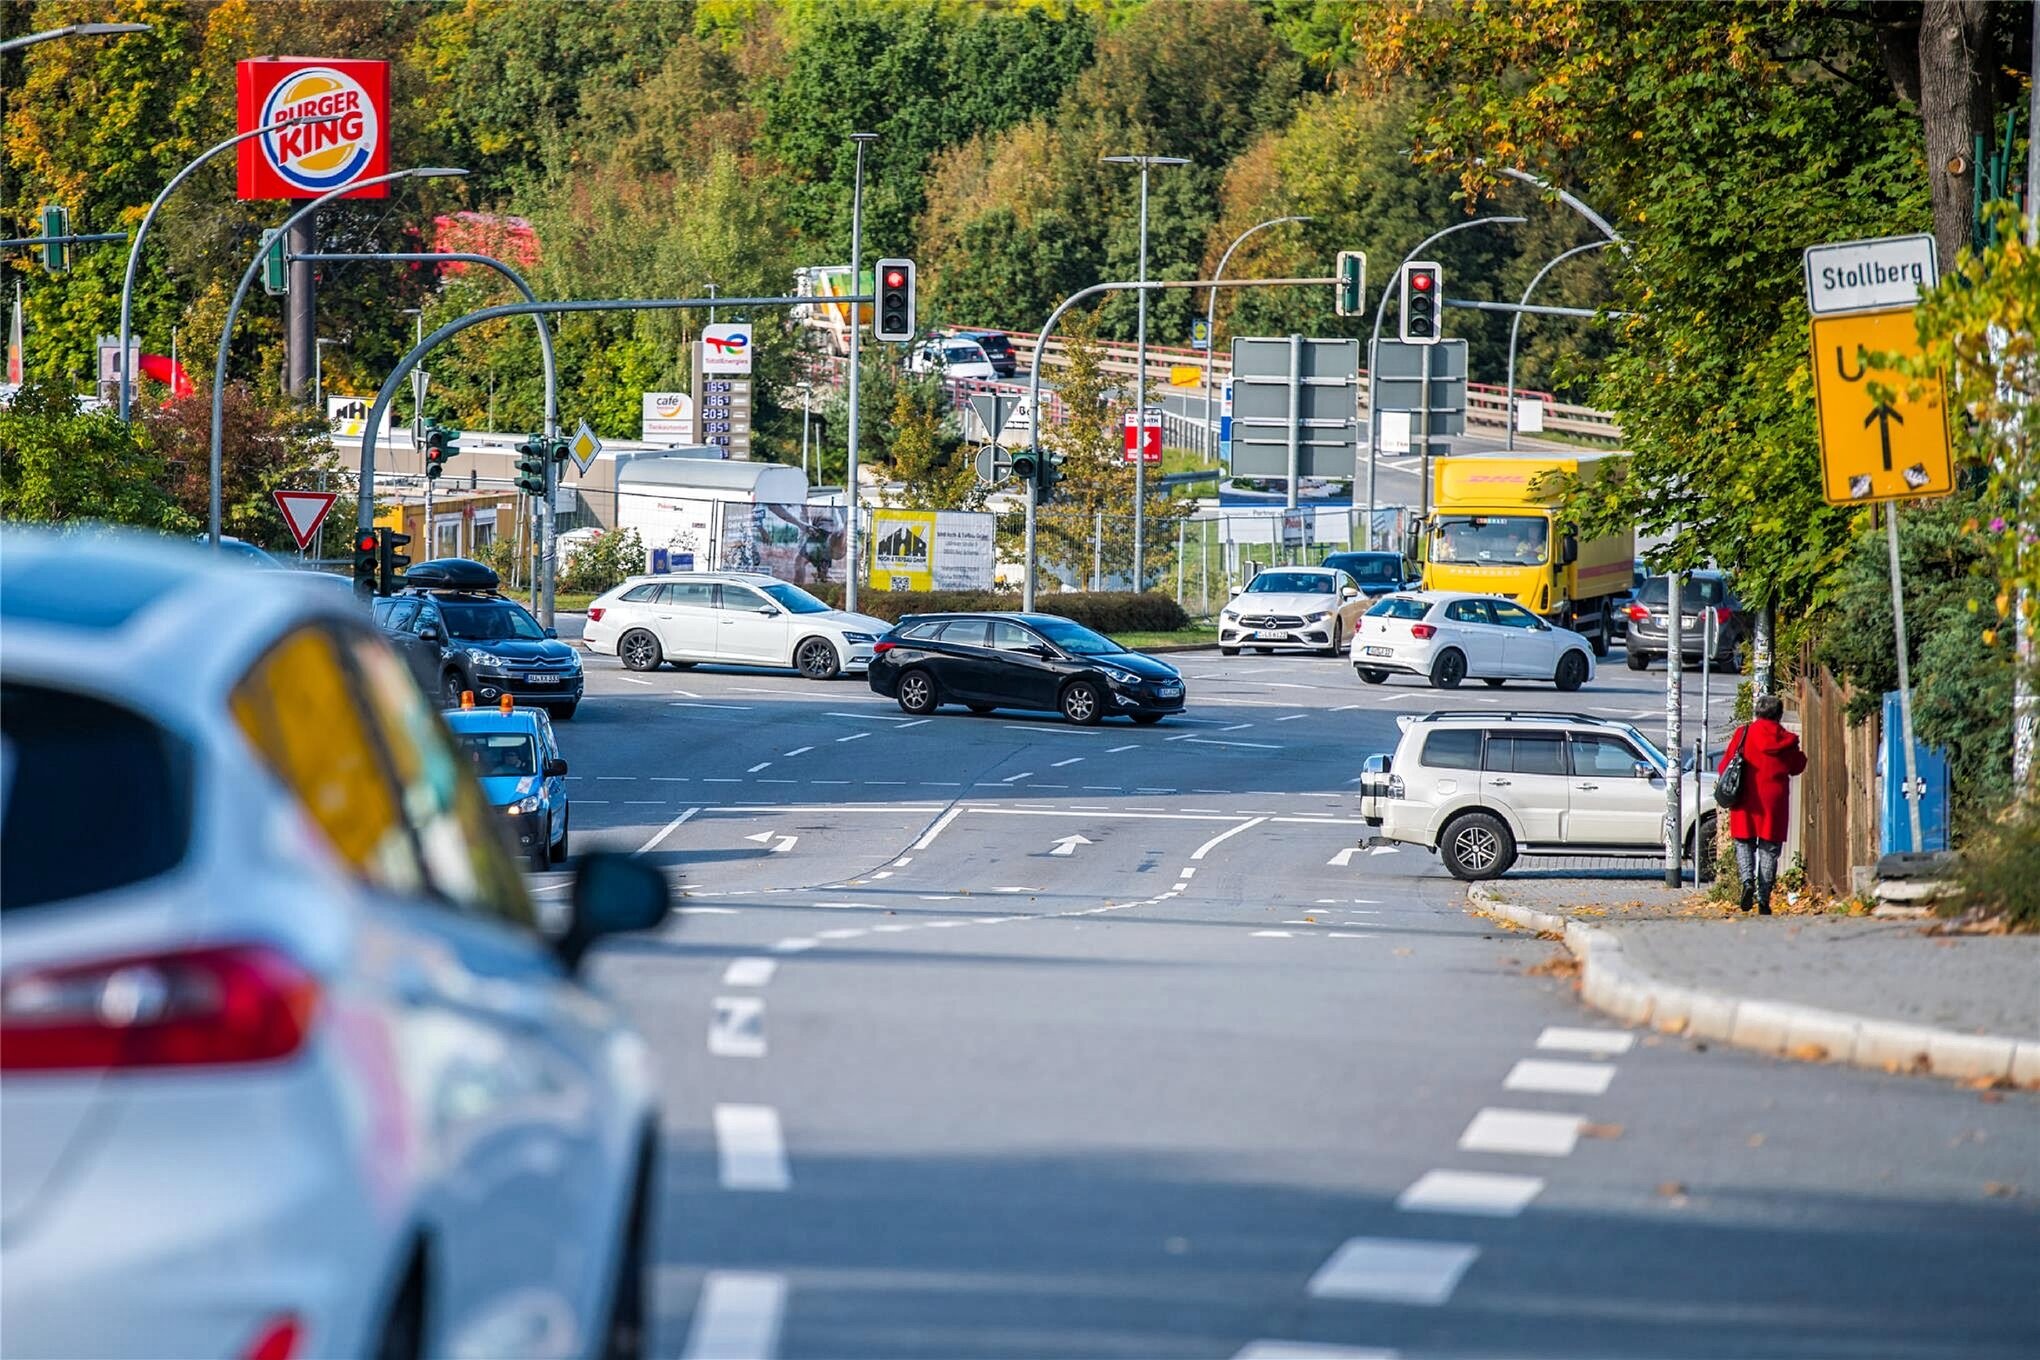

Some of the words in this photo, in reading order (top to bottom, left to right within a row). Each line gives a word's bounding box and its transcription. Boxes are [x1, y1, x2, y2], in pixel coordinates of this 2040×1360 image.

[275, 90, 359, 134] BURGER
[280, 111, 363, 164] KING
[1823, 262, 1923, 290] Stollberg
[656, 395, 679, 406] café
[879, 528, 926, 556] MHR
